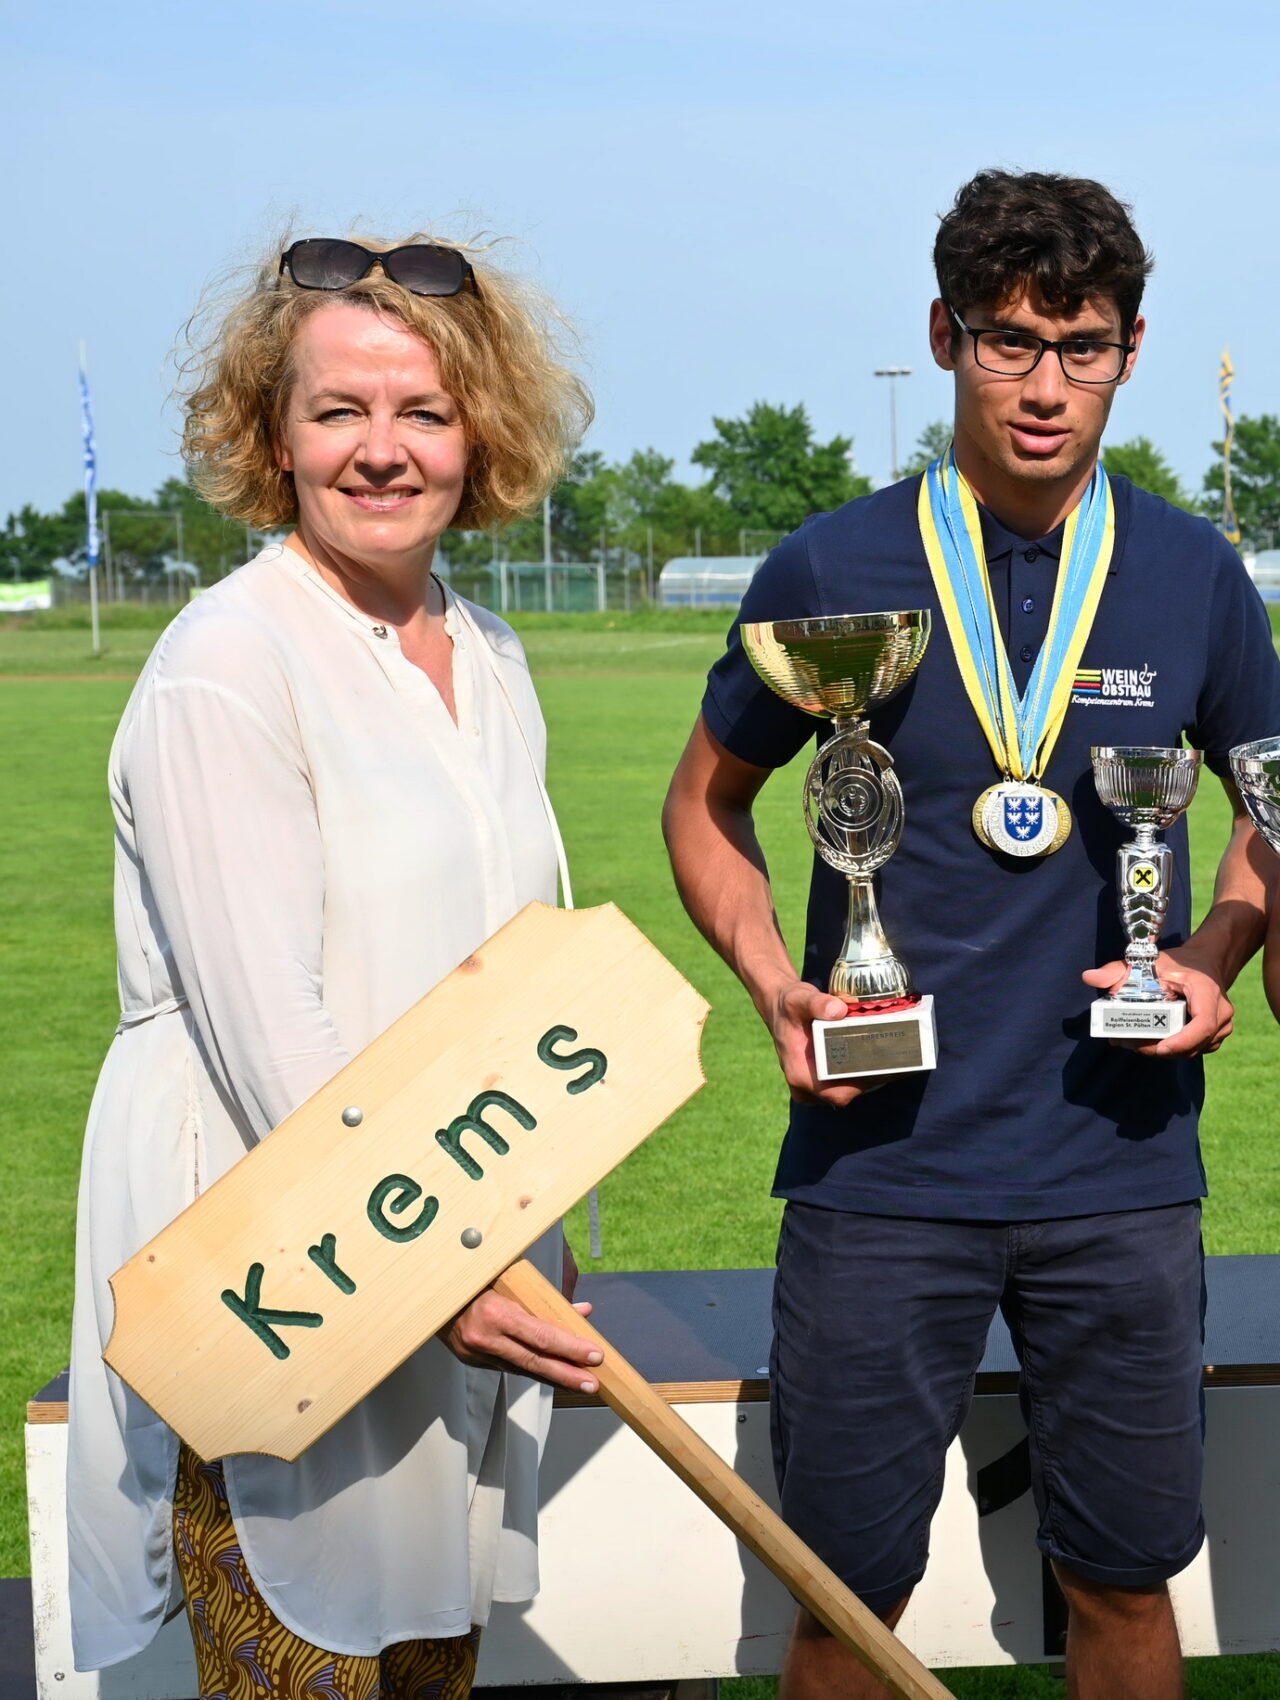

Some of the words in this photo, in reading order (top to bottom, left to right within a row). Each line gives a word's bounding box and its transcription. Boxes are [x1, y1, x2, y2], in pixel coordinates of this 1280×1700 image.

[1101, 668, 1138, 685] WEIN
[1139, 663, 1157, 685] &
[1101, 684, 1152, 698] OBSTBAU
[221, 1024, 608, 1360] Krems
